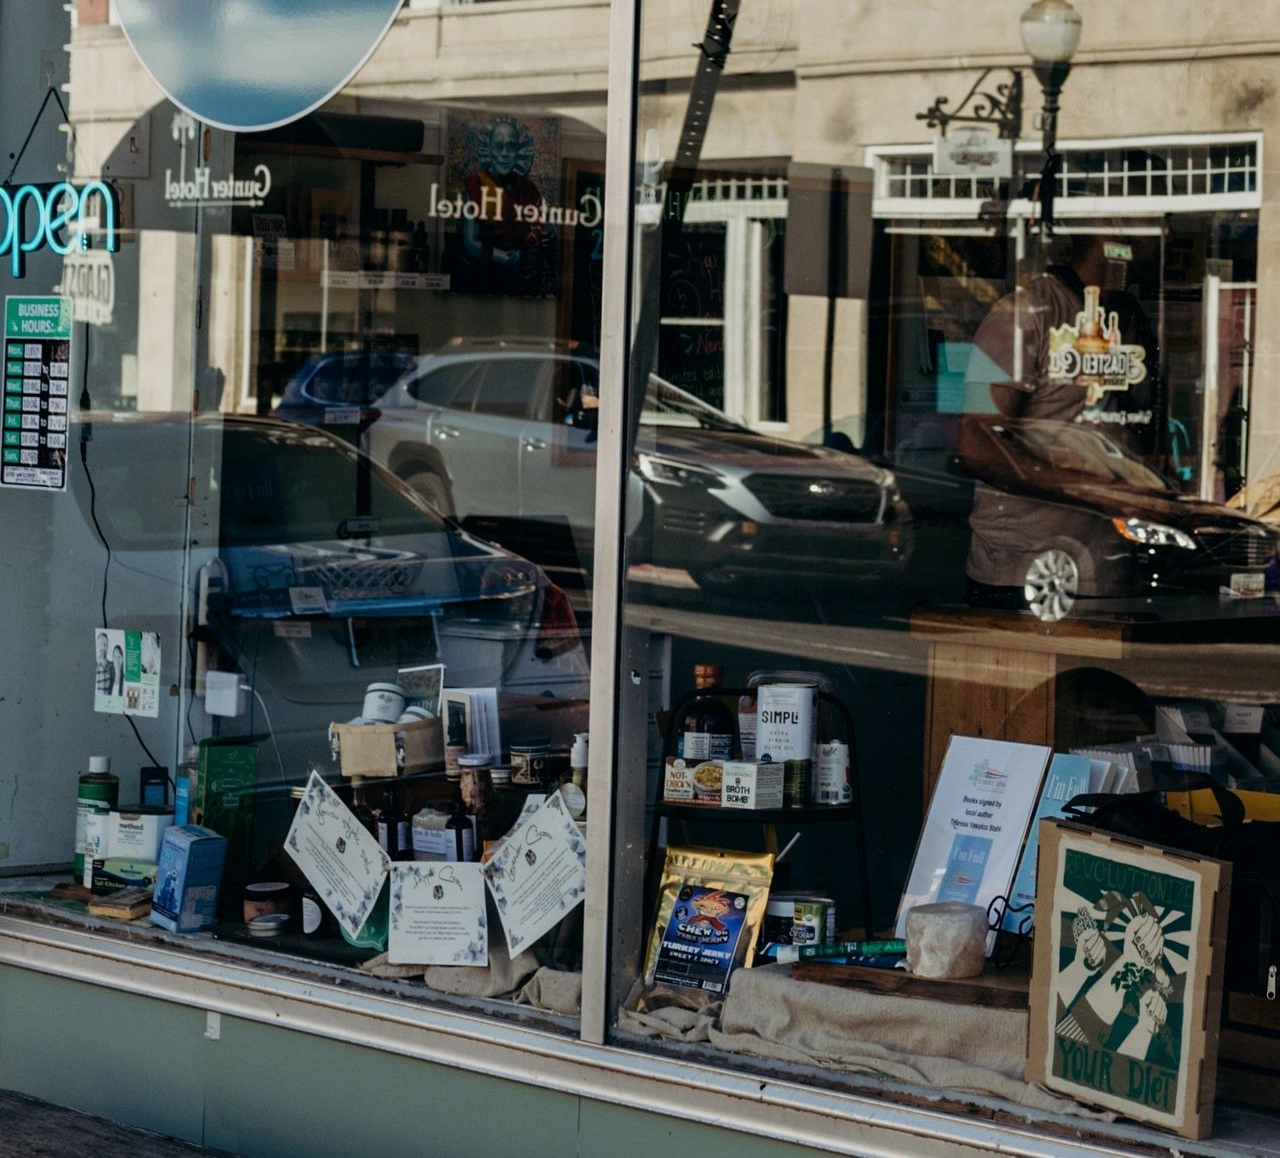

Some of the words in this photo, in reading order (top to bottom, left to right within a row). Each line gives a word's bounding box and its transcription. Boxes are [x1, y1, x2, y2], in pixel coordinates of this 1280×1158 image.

[18, 304, 59, 318] BUSINESS
[22, 320, 54, 333] HOURS:
[41, 382, 48, 391] to
[41, 400, 48, 409] to
[40, 418, 47, 426] to
[40, 435, 46, 444] to
[726, 784, 751, 795] BROTH
[963, 795, 978, 805] Books
[979, 798, 995, 807] signed
[996, 800, 1002, 809] by
[977, 810, 993, 819] author
[119, 823, 144, 831] method
[678, 923, 711, 936] CHEW
[663, 941, 701, 954] TURKEY
[702, 949, 732, 960] JERKY
[1058, 1036, 1118, 1088] YOUR
